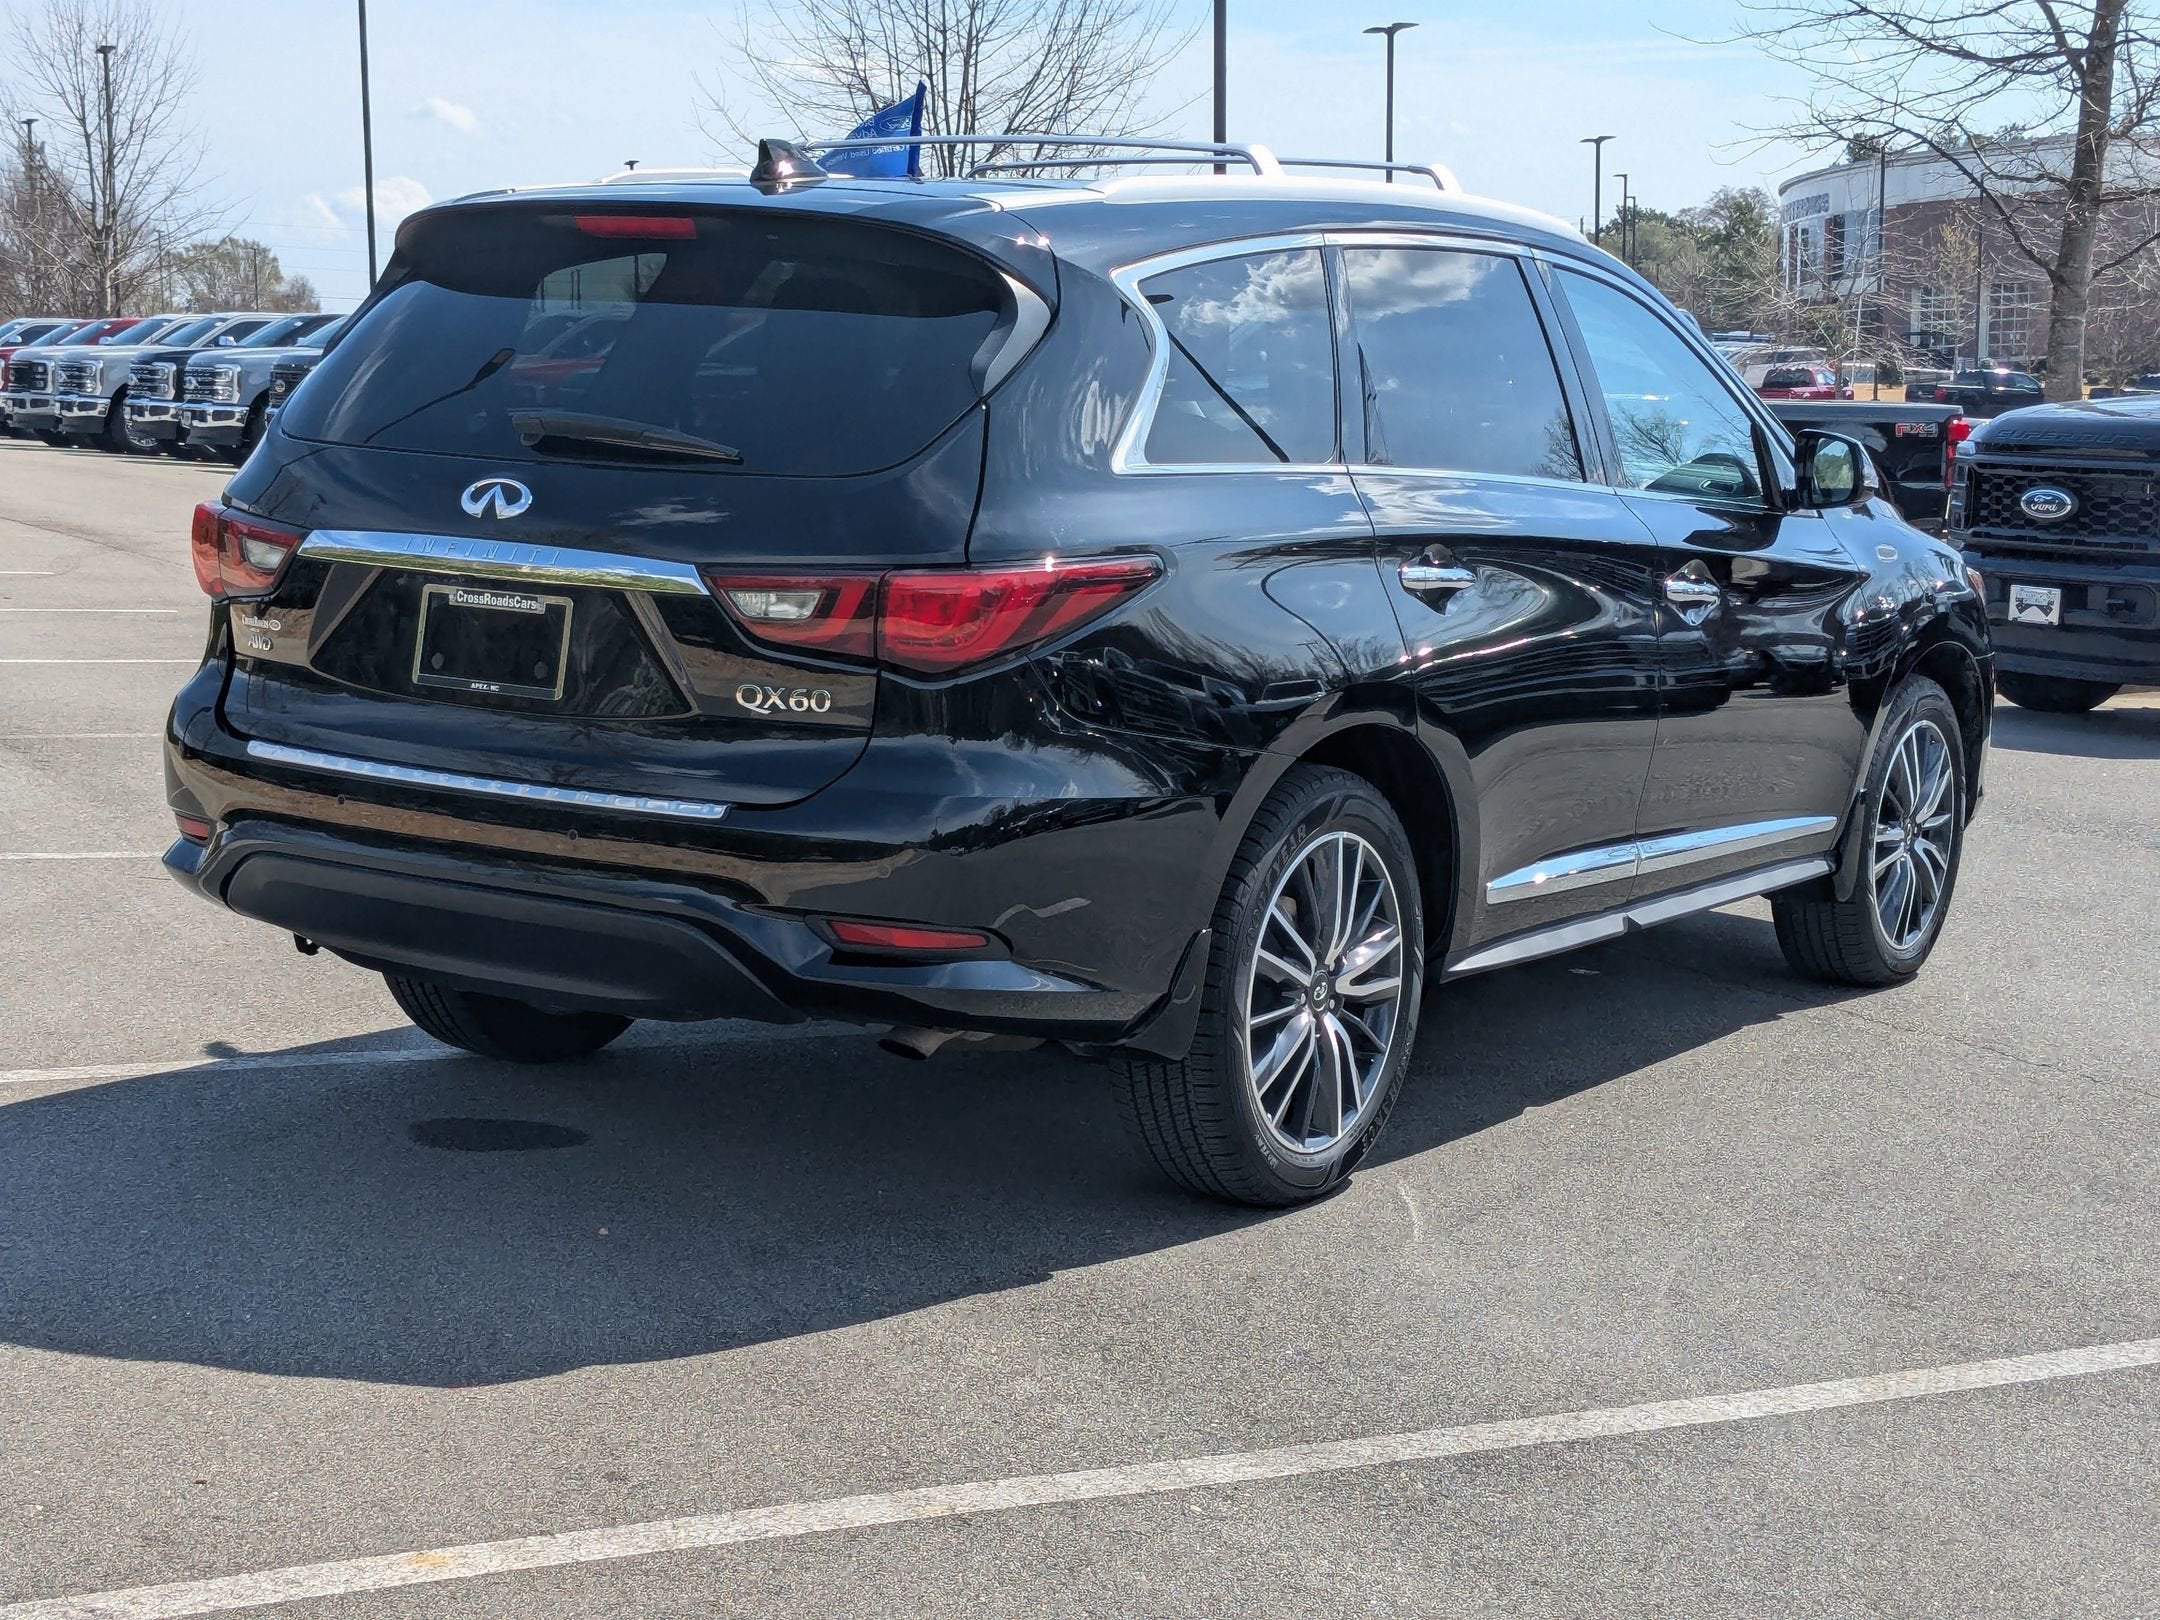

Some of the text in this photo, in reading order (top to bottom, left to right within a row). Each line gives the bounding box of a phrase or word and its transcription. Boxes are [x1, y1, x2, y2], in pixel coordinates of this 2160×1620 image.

[1894, 423, 1938, 437] FX4
[2029, 494, 2060, 512] Ford
[403, 537, 560, 565] INFINITI
[456, 590, 538, 610] CrossRoadsCars
[248, 634, 272, 651] AWD
[736, 684, 831, 715] QX60
